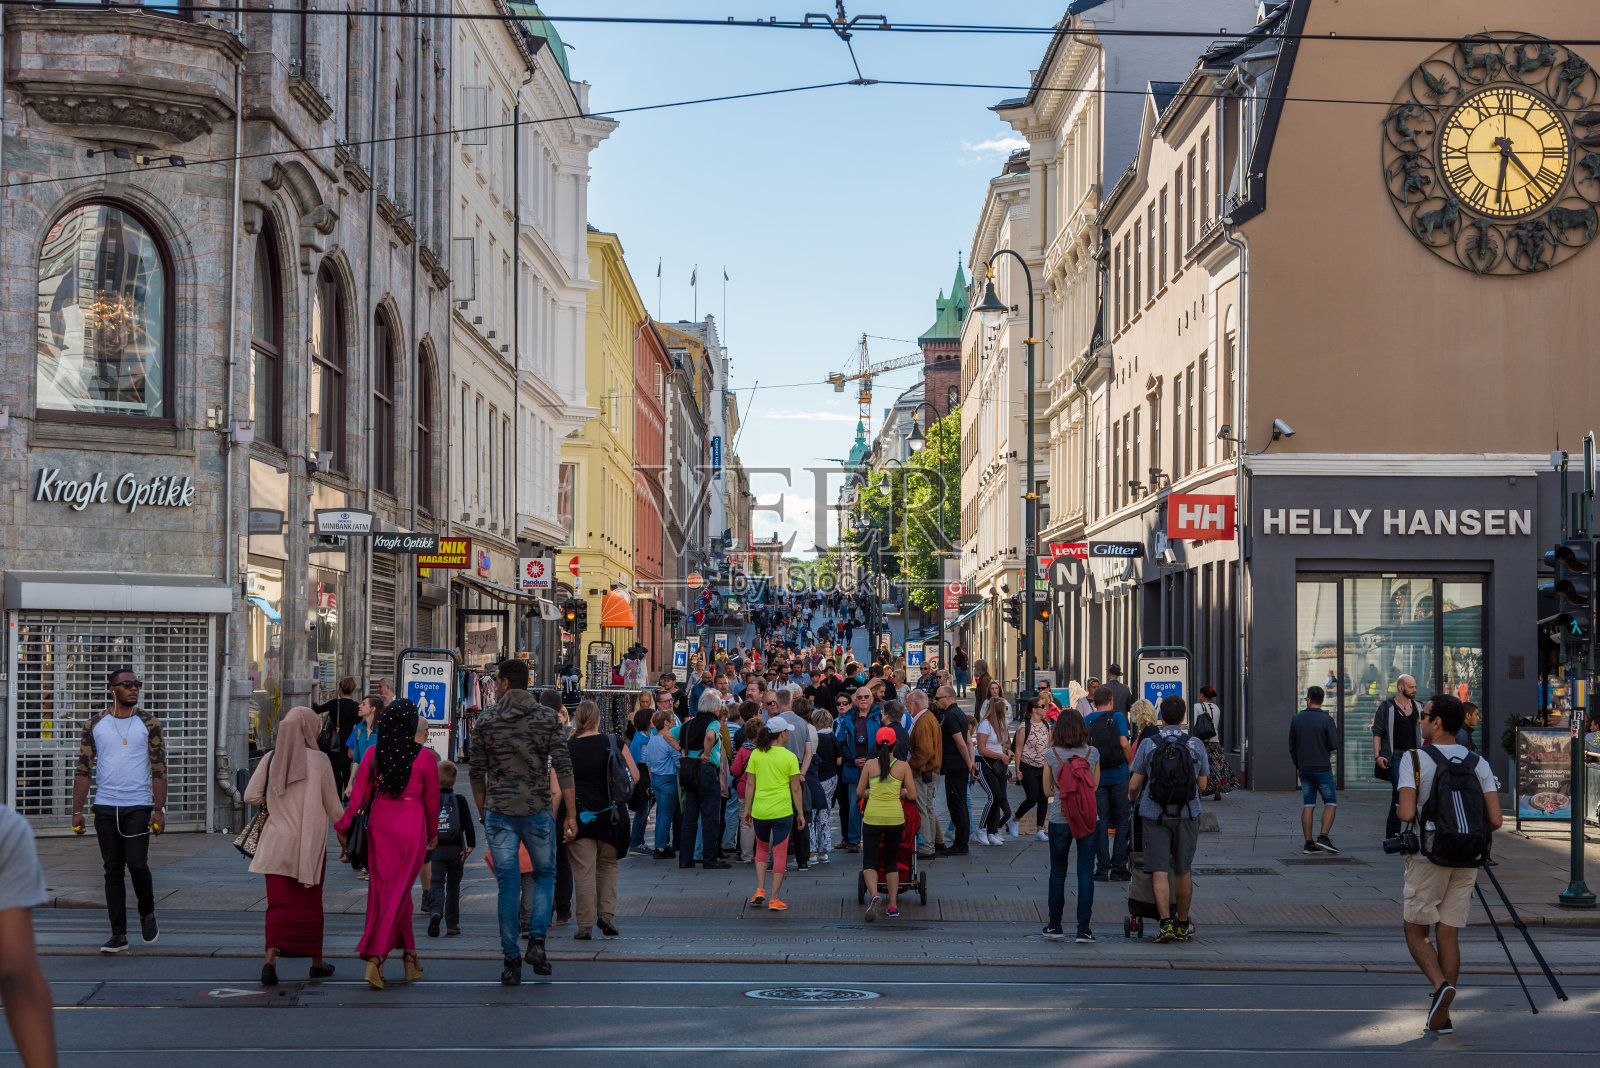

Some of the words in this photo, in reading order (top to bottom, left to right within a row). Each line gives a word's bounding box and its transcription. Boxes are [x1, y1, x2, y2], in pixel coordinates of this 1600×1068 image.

[34, 467, 109, 511] Krogh
[115, 472, 196, 513] Optikk
[1178, 503, 1225, 530] HH
[1263, 508, 1372, 535] HELLY
[1383, 509, 1532, 536] HANSEN
[374, 534, 401, 550] Krogh
[403, 536, 434, 551] Optikk
[1093, 544, 1138, 555] Glitter
[417, 555, 467, 565] MAGASINET
[1056, 562, 1078, 586] N
[412, 663, 444, 676] Sone
[1147, 662, 1179, 675] Sone
[414, 682, 440, 691] Gågate
[1150, 682, 1176, 691] Gågate
